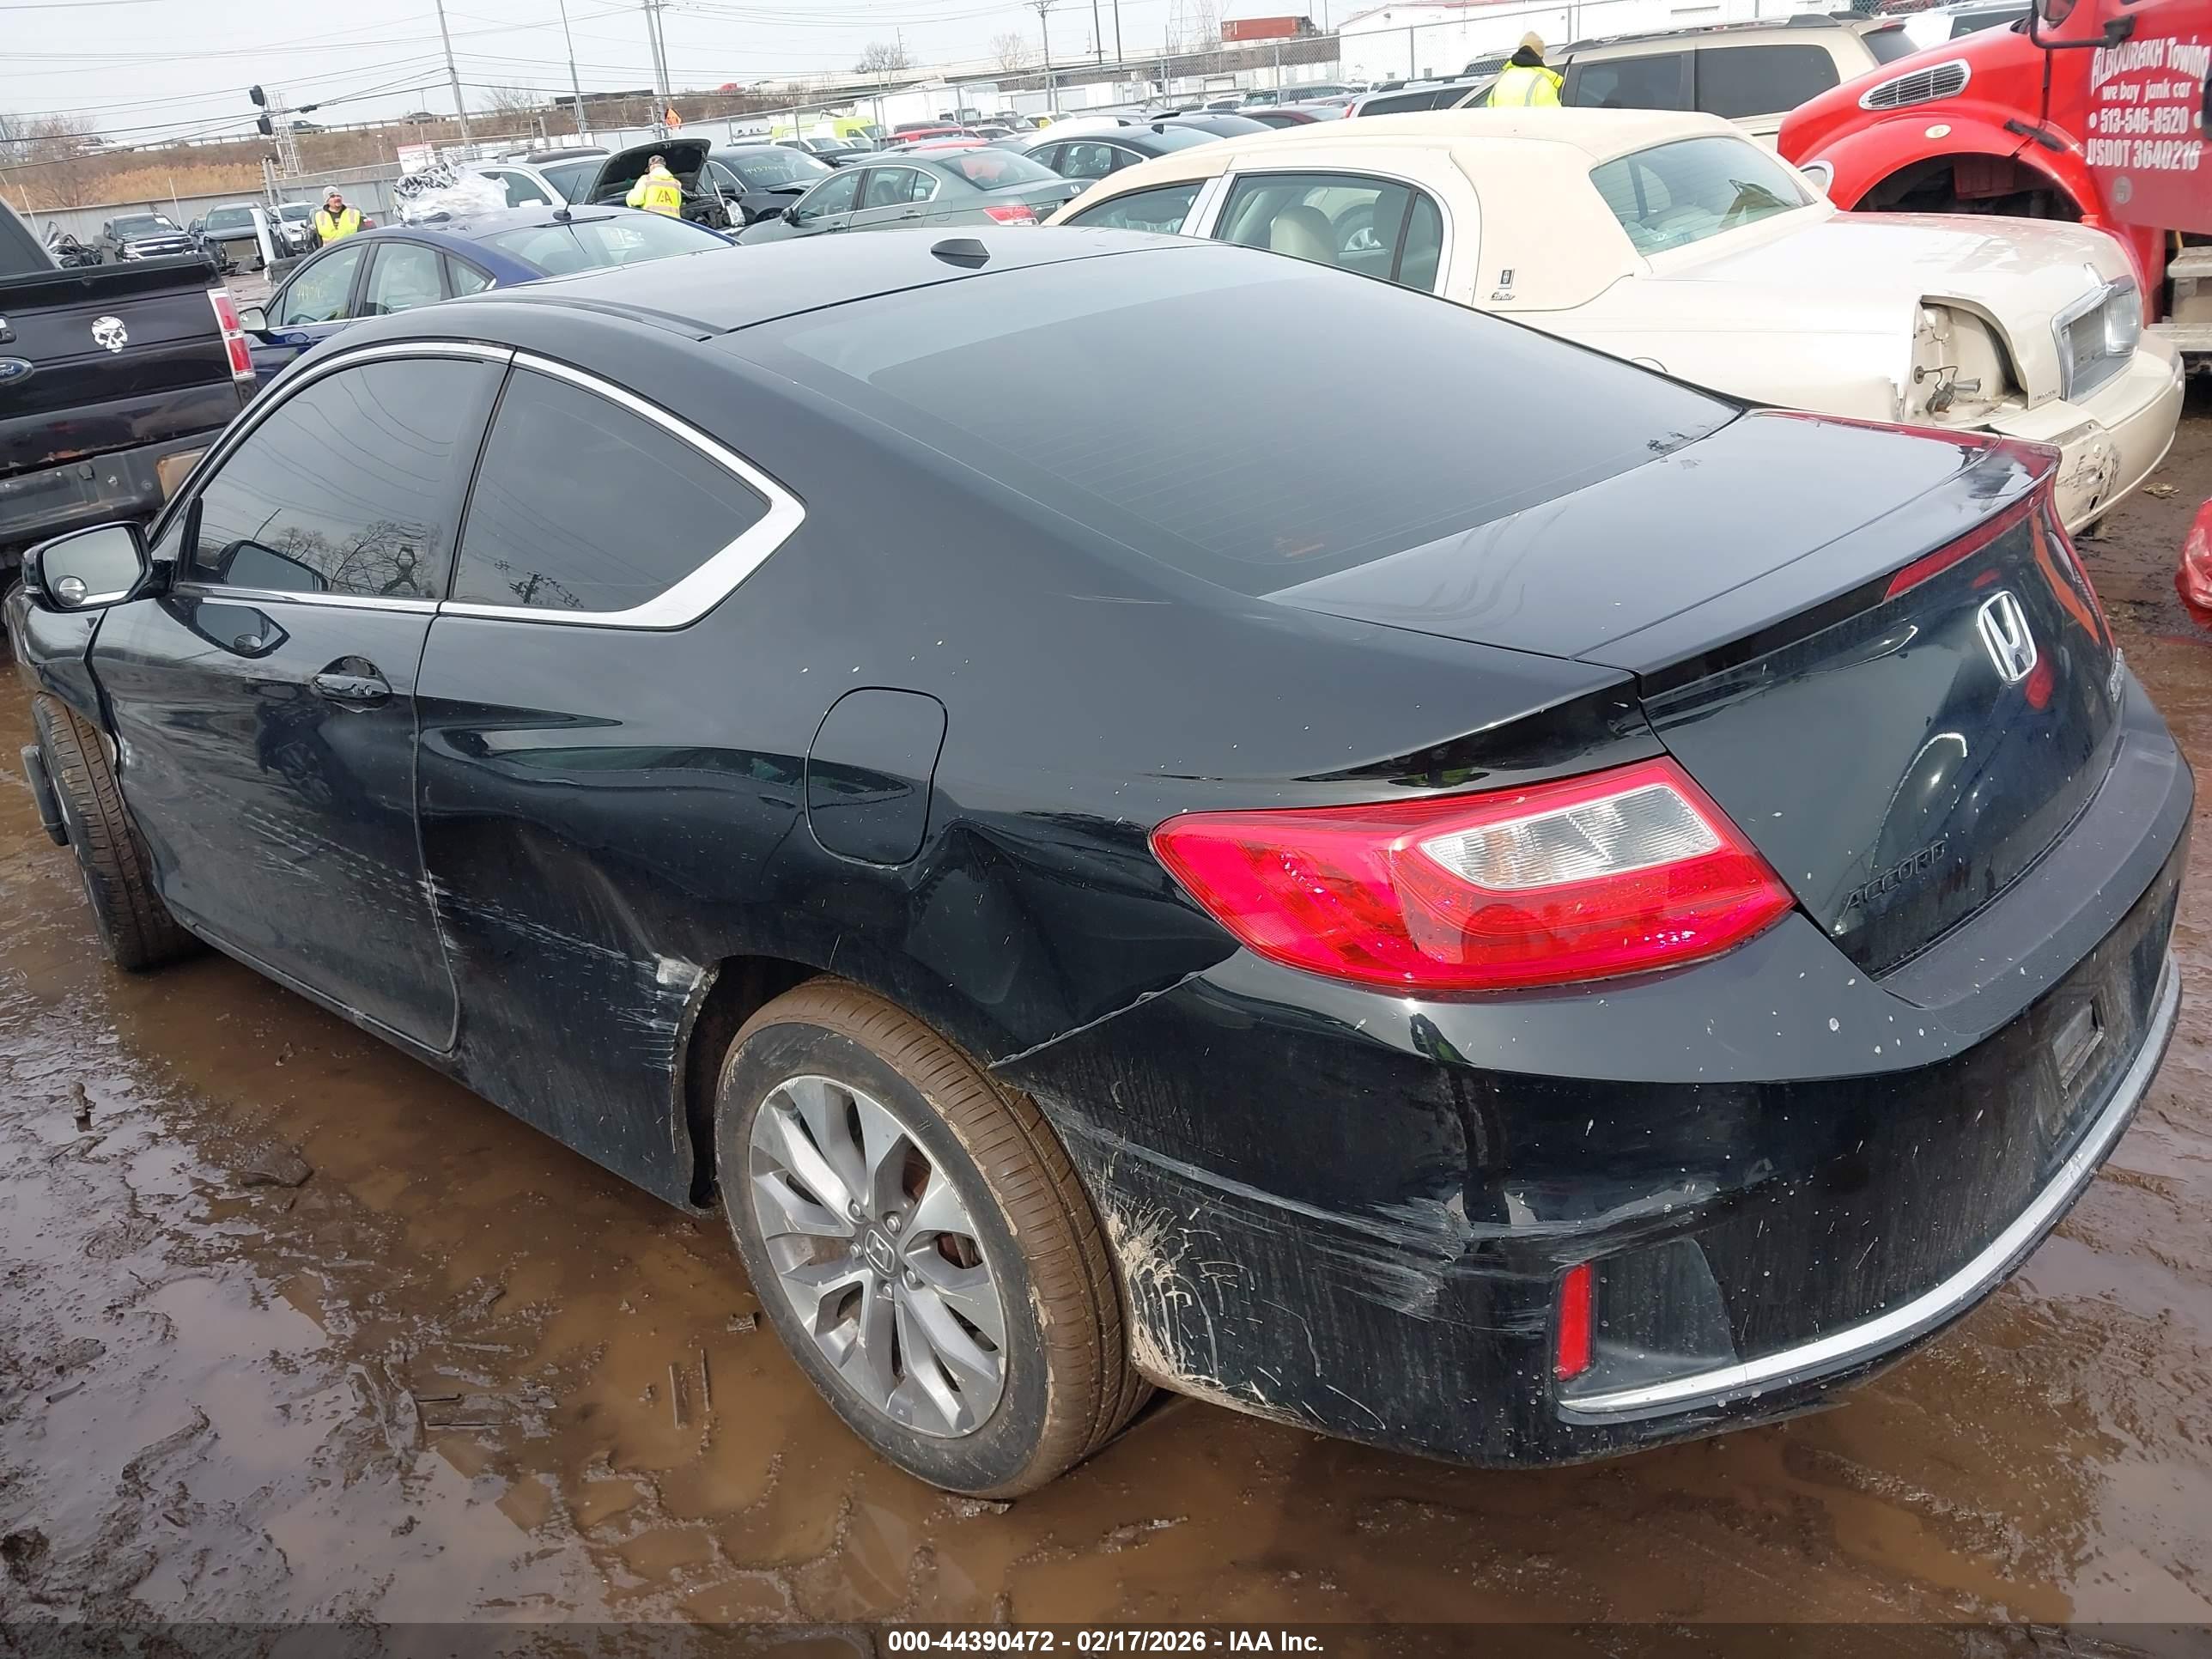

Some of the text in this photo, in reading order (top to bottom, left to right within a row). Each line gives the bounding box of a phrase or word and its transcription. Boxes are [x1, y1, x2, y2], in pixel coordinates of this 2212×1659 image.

[2166, 35, 2211, 93] Towing
[2102, 78, 2191, 105] we buy junk car
[2100, 106, 2189, 134] 513-546-8520
[2087, 138, 2203, 170] USDOT 3640216
[1839, 839, 1946, 919] ACCORD
